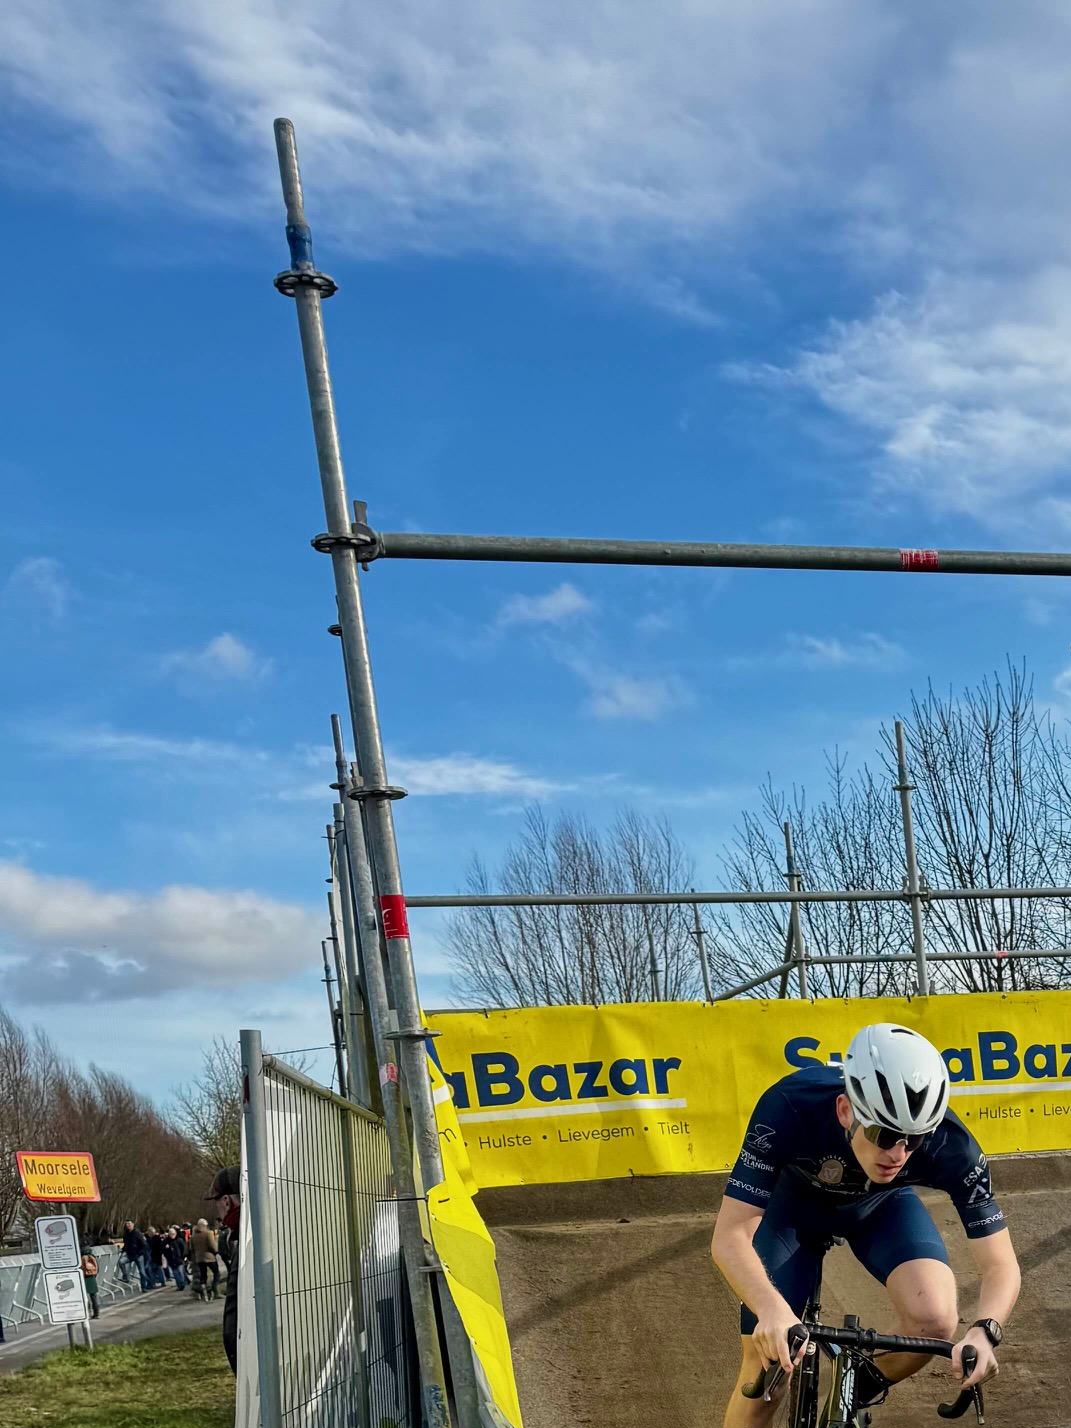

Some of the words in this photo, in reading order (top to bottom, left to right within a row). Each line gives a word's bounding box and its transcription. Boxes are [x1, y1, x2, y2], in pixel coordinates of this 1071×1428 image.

[443, 1051, 682, 1109] aBazar
[979, 1106, 1022, 1120] Hulste
[479, 1132, 532, 1150] Hulste
[557, 1125, 635, 1143] Lievegem
[657, 1121, 690, 1135] Tielt
[24, 1158, 90, 1176] Moorsele
[37, 1183, 86, 1197] Wevelgem
